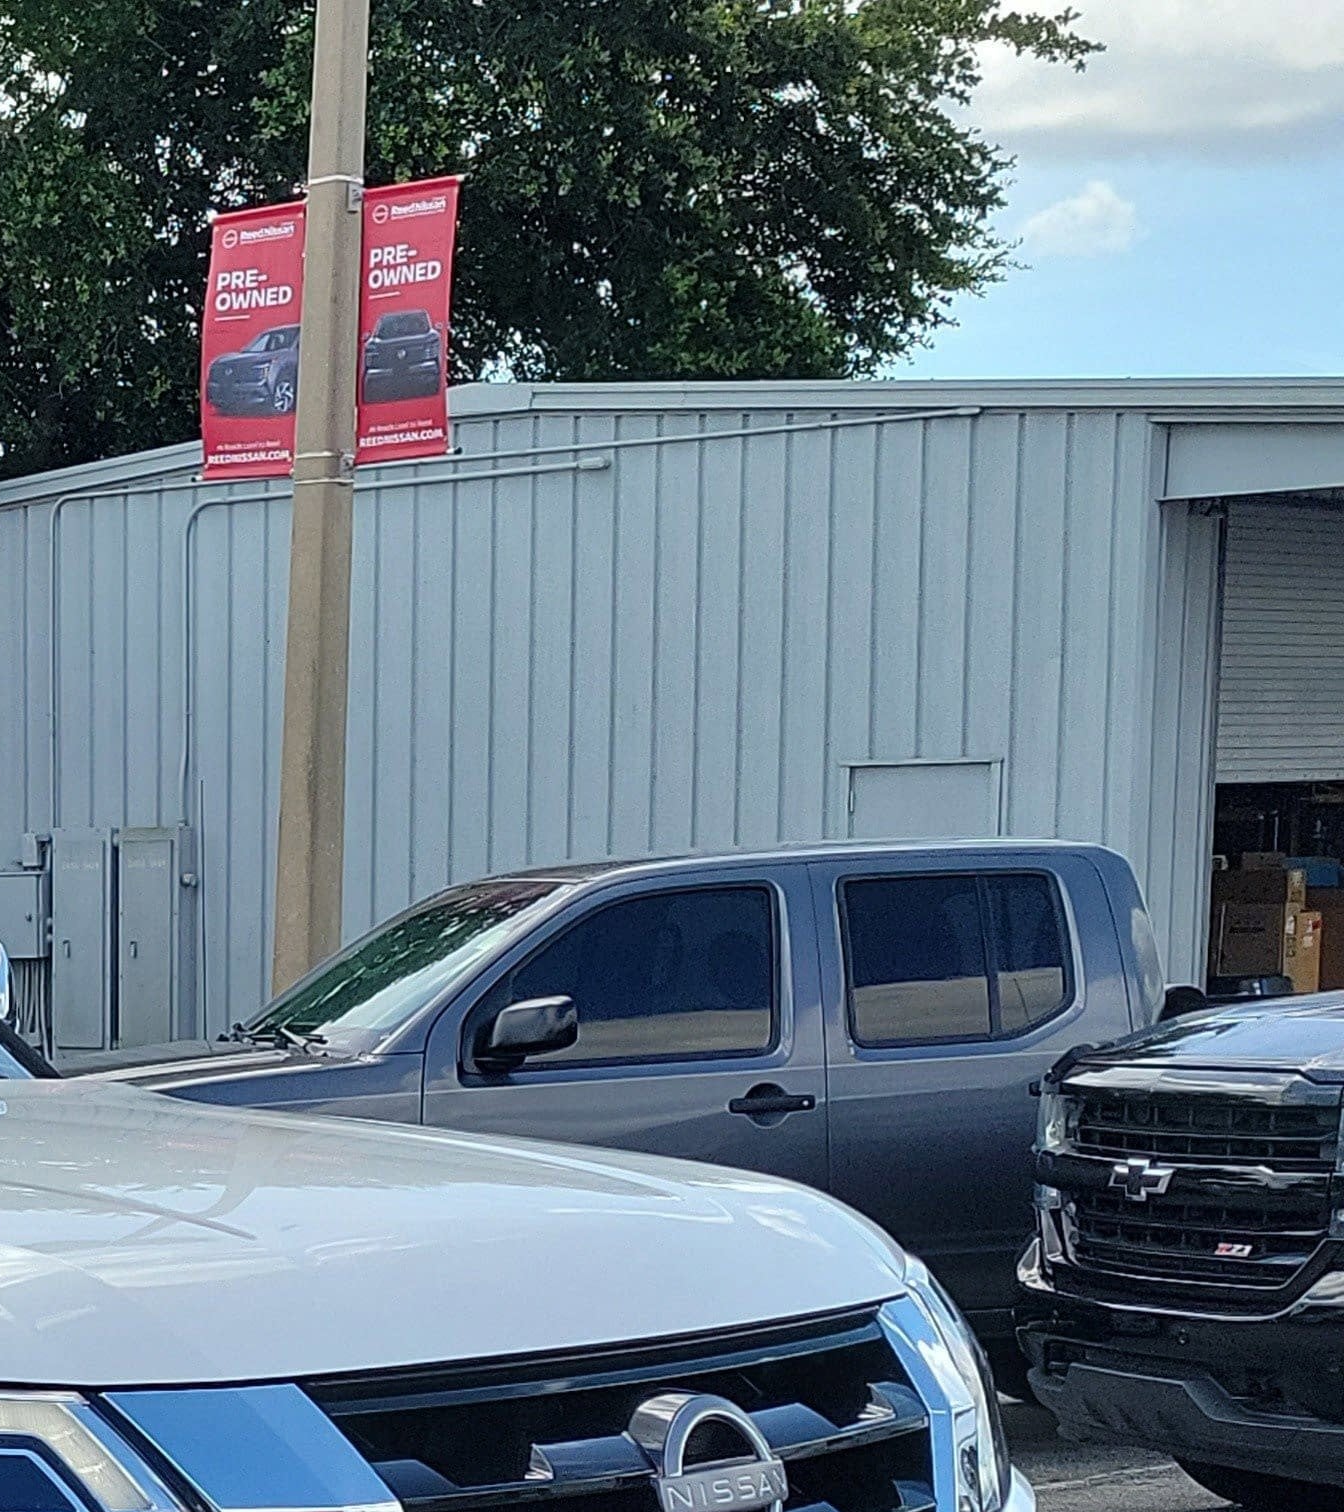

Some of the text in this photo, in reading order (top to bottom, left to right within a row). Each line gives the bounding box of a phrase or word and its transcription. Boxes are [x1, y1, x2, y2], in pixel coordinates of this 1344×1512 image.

[369, 244, 417, 268] PRE-
[216, 269, 268, 292] PRE-
[368, 260, 441, 289] OWNED
[215, 285, 293, 311] OWNED
[666, 1469, 787, 1511] NISSAN
